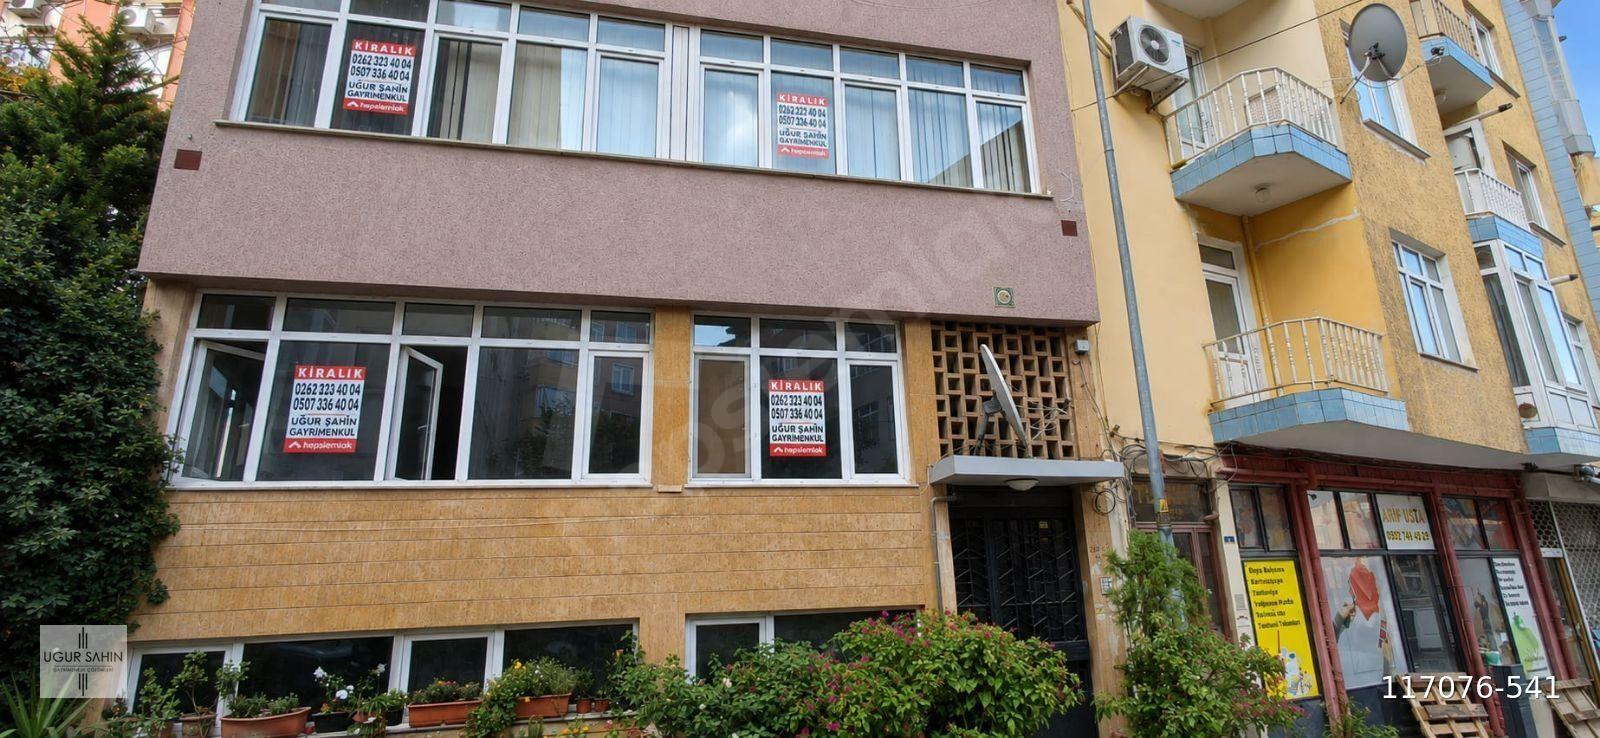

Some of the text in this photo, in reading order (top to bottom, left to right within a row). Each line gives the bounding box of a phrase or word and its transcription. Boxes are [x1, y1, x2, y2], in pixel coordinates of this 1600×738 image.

[355, 41, 412, 56] KİRALIK
[352, 54, 411, 70] 0262 323 40 04
[350, 66, 410, 81] 0507 336 40 04
[779, 94, 825, 105] KİRALIK
[808, 107, 817, 117] 40
[298, 366, 362, 378] KİRALIK
[295, 383, 361, 396] 0262 323 40 04
[771, 380, 821, 391] KİRALIK
[293, 398, 359, 411] 0507 336 40 04
[771, 395, 822, 406] 0262 323 40 04
[771, 408, 823, 420] 0507 336 40 04
[291, 415, 357, 427] UĞUR ŞAHİN
[772, 423, 823, 434] UĞUR ŞAHİN
[1403, 508, 1426, 524] USTA
